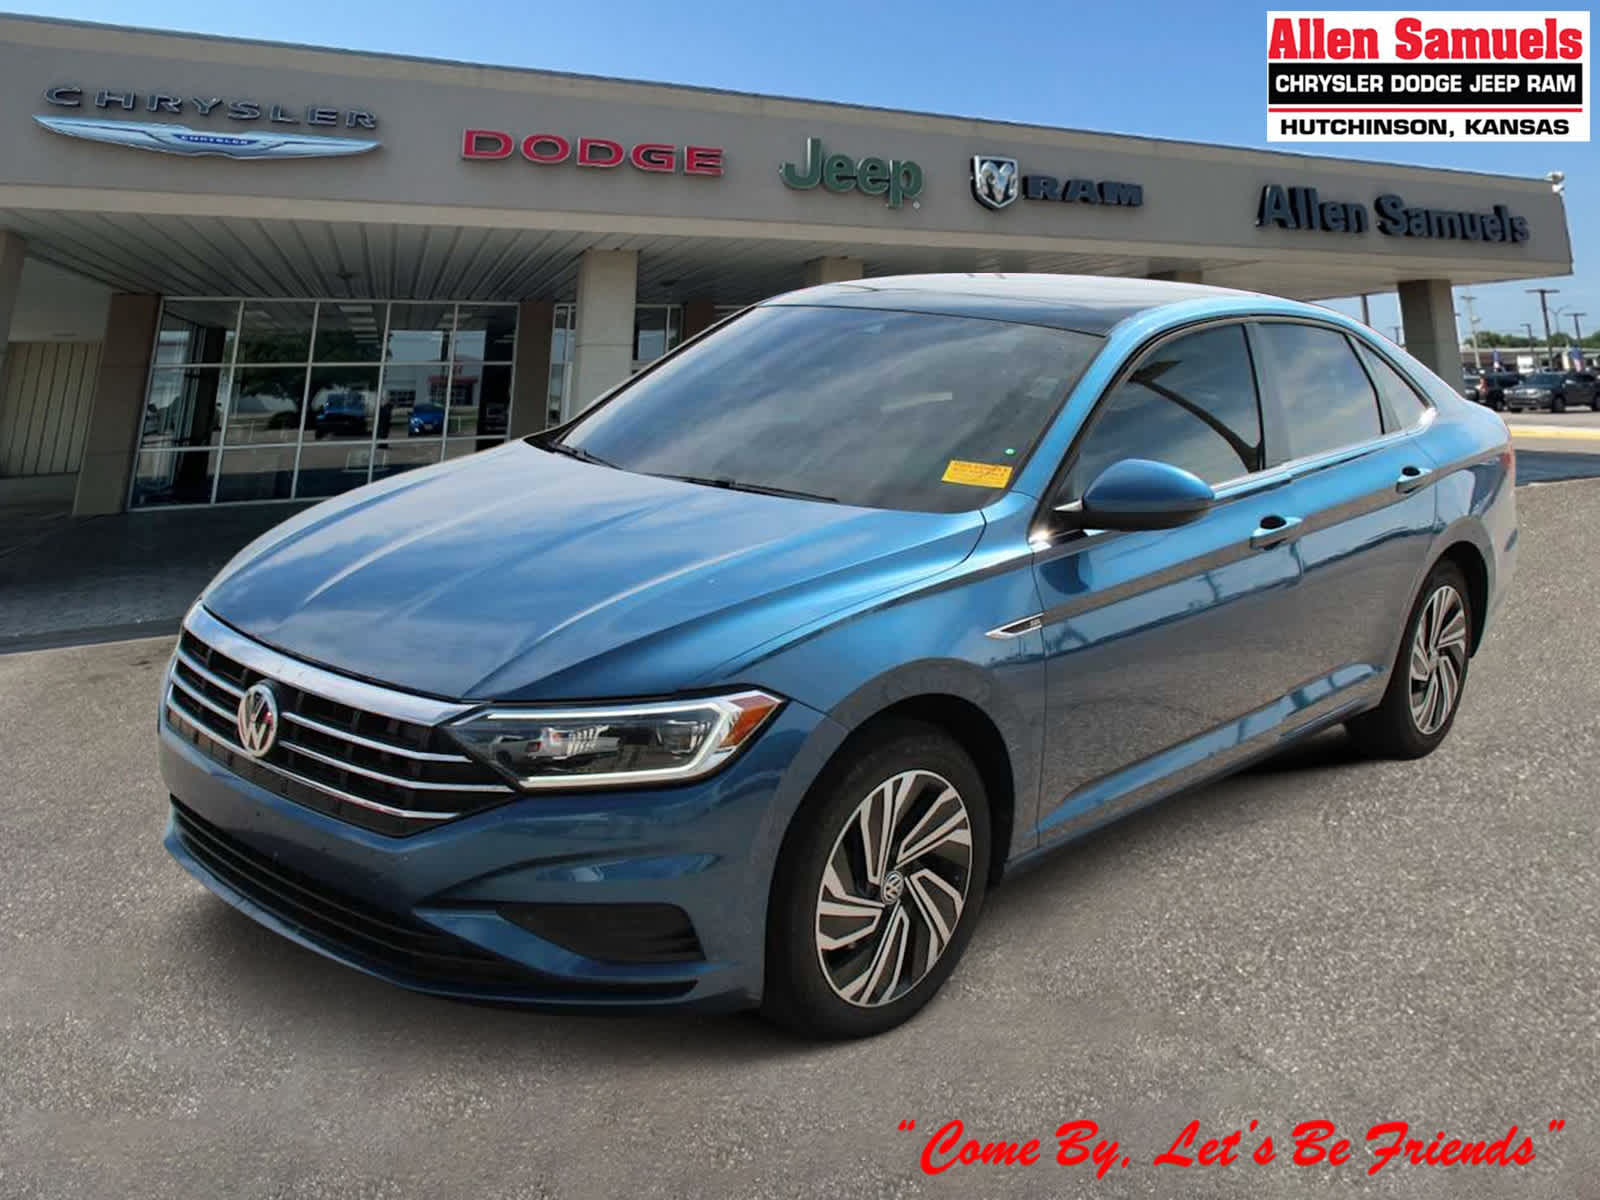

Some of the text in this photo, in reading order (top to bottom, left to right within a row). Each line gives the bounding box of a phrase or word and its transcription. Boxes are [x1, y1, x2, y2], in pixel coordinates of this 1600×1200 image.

[45, 86, 378, 129] CHRYSLER
[461, 128, 725, 176] DODGE
[779, 136, 924, 210] Jeep
[1023, 175, 1144, 207] RAM
[1256, 184, 1531, 242] Allen Samuels
